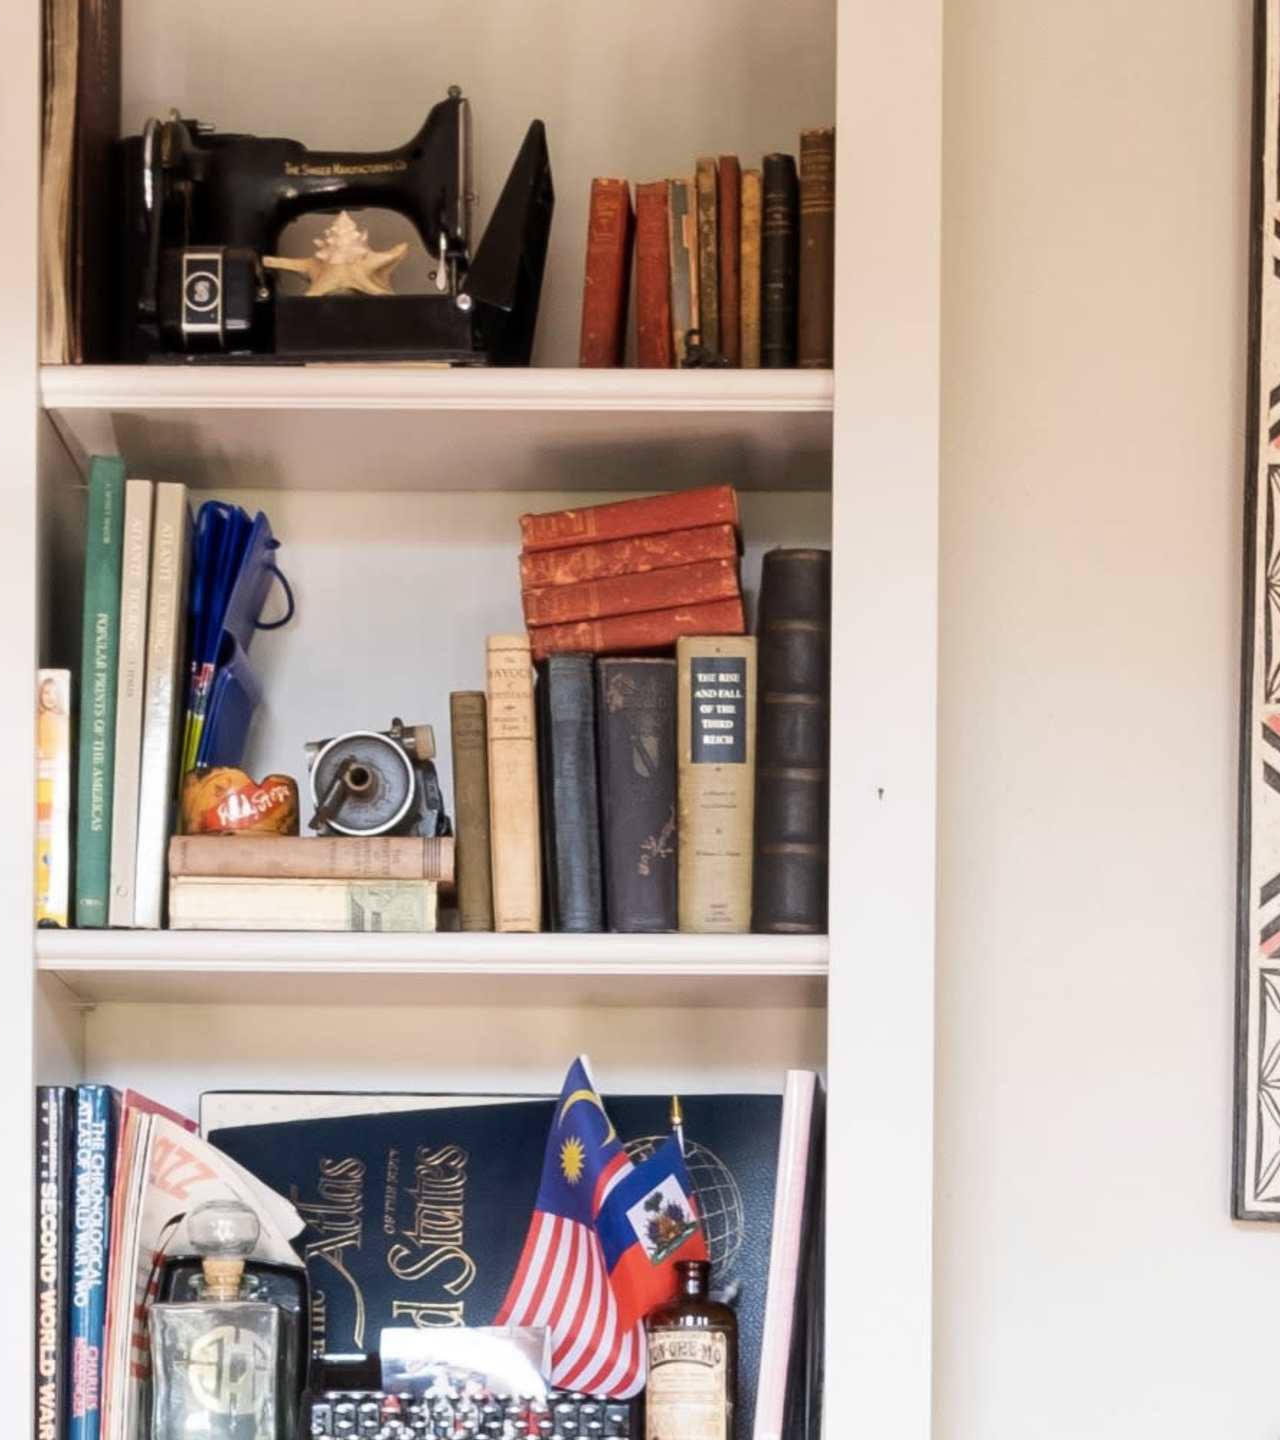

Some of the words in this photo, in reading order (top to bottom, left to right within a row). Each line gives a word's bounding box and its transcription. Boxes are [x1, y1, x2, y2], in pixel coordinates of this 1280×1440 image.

[129, 517, 142, 576] ATLANTE
[158, 522, 172, 583] ATLANTE
[94, 612, 109, 670] POPULAR
[156, 593, 170, 653] TOURING
[93, 672, 107, 717] PRINTS
[693, 688, 718, 699] AND
[718, 688, 742, 699] FALL
[696, 672, 717, 683] THE
[92, 719, 107, 736] OF
[699, 704, 714, 714] OF
[715, 704, 736, 715] THE
[92, 739, 106, 763] THE
[90, 766, 104, 832] AMERICAS
[76, 1100, 94, 1144] ATLAS
[90, 1120, 106, 1152] THE
[77, 1146, 93, 1171] OF
[76, 1174, 92, 1231] WORLD
[89, 1154, 105, 1287] CHRONOLOGICAL
[387, 1144, 478, 1295] States
[39, 1183, 58, 1282] SECOND
[75, 1232, 90, 1264] WAR
[305, 1157, 367, 1349] Atlas
[74, 1266, 88, 1307] TWO
[39, 1289, 56, 1376] WORLD
[86, 1346, 99, 1410] CHARLES
[37, 1382, 55, 1440] WAR
